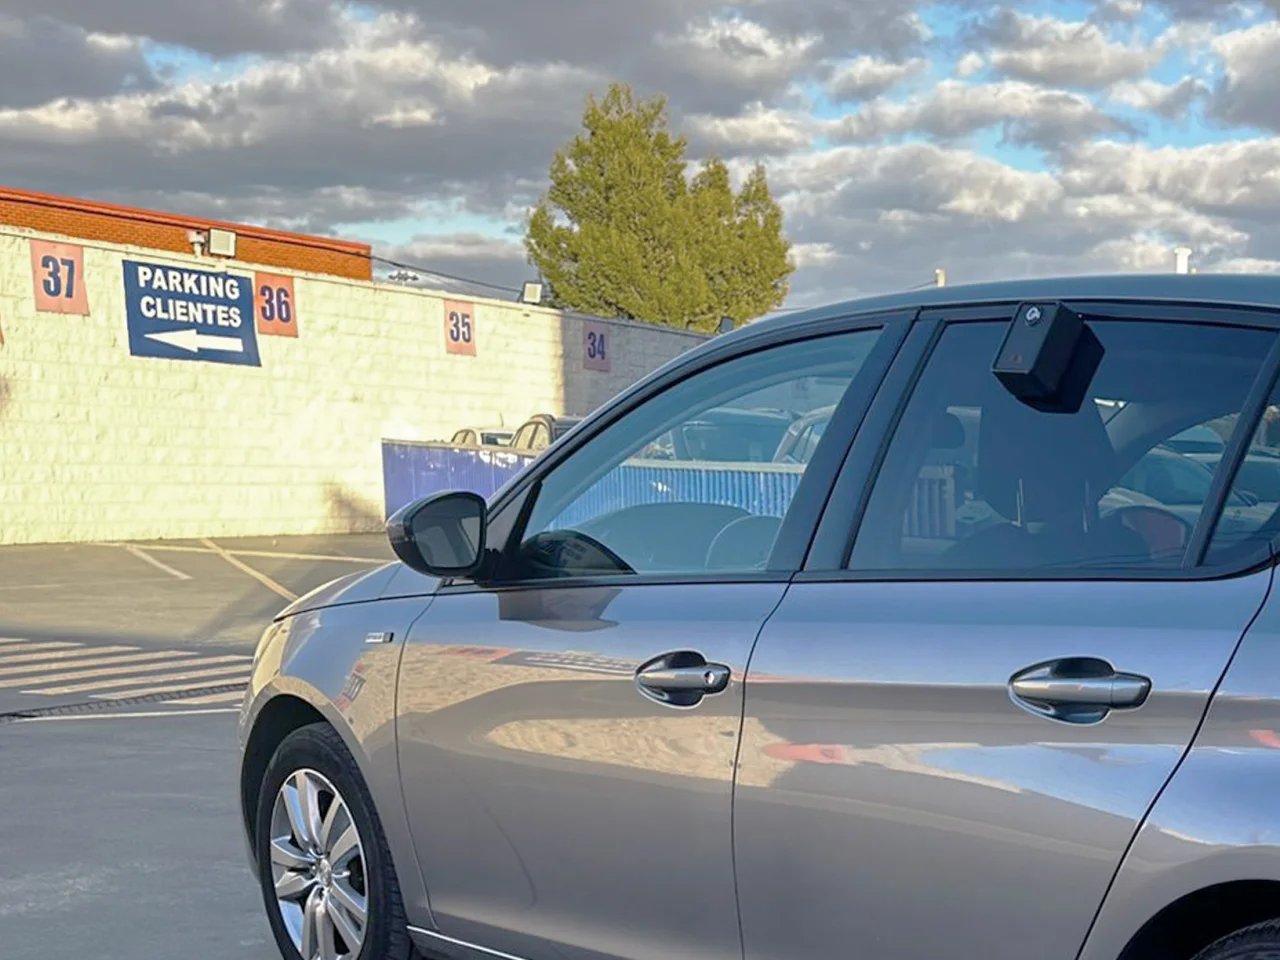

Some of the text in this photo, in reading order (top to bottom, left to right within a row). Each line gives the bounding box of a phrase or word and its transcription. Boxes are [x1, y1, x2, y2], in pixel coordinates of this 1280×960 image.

[40, 254, 76, 299] 37
[137, 266, 241, 300] PARKING
[139, 296, 242, 328] CLIENTES
[259, 285, 292, 323] 36
[449, 311, 472, 344] 35
[587, 331, 606, 360] 34
